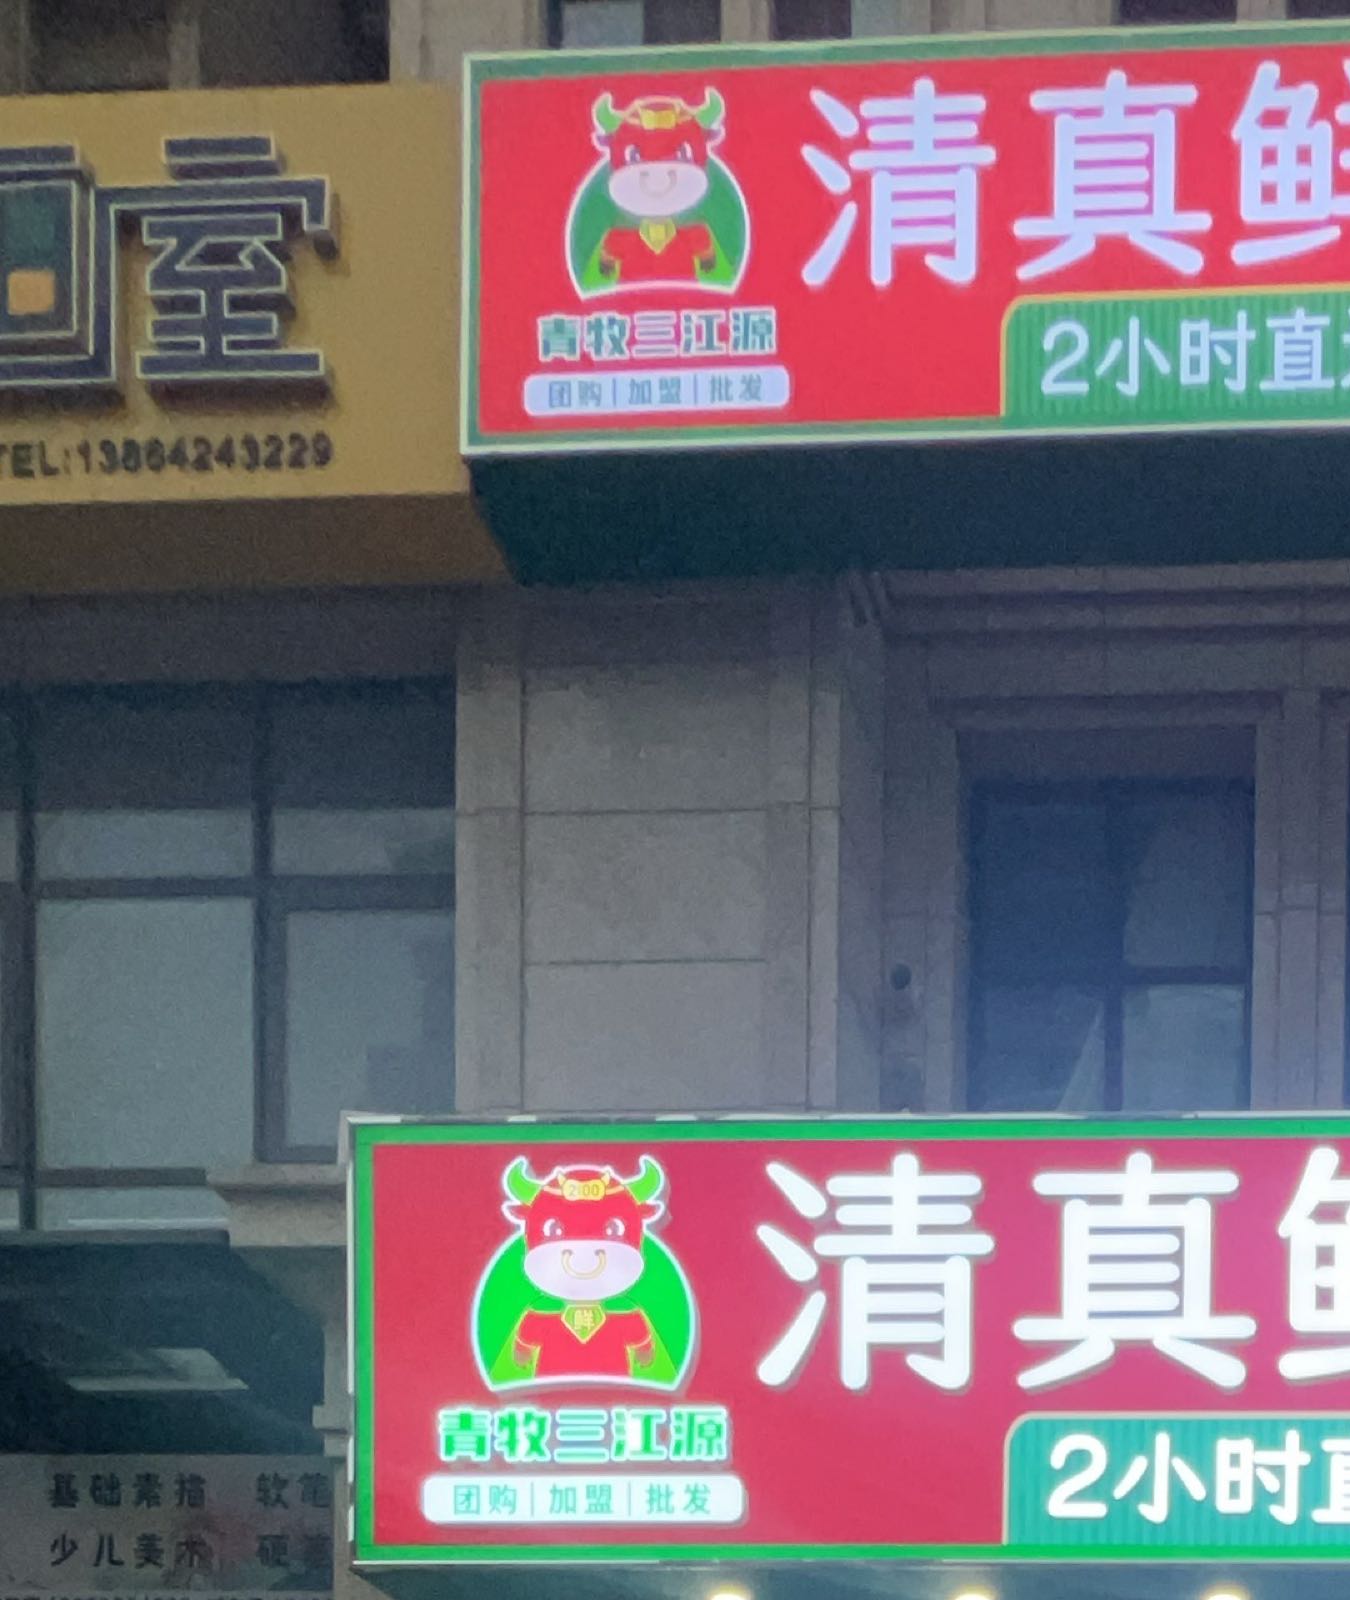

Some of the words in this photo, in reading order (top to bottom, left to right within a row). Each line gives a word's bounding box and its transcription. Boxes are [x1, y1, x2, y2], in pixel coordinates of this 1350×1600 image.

[537, 306, 776, 362] 青牧三江源
[628, 377, 681, 406] 加盟
[710, 374, 762, 402] 批发
[439, 1408, 729, 1463] 青牧三江源
[48, 1472, 206, 1509] 基础素描
[453, 1484, 517, 1516] 团购
[549, 1483, 612, 1515] 加盟
[645, 1482, 711, 1515] 批发
[50, 1531, 212, 1569] 少儿美术
